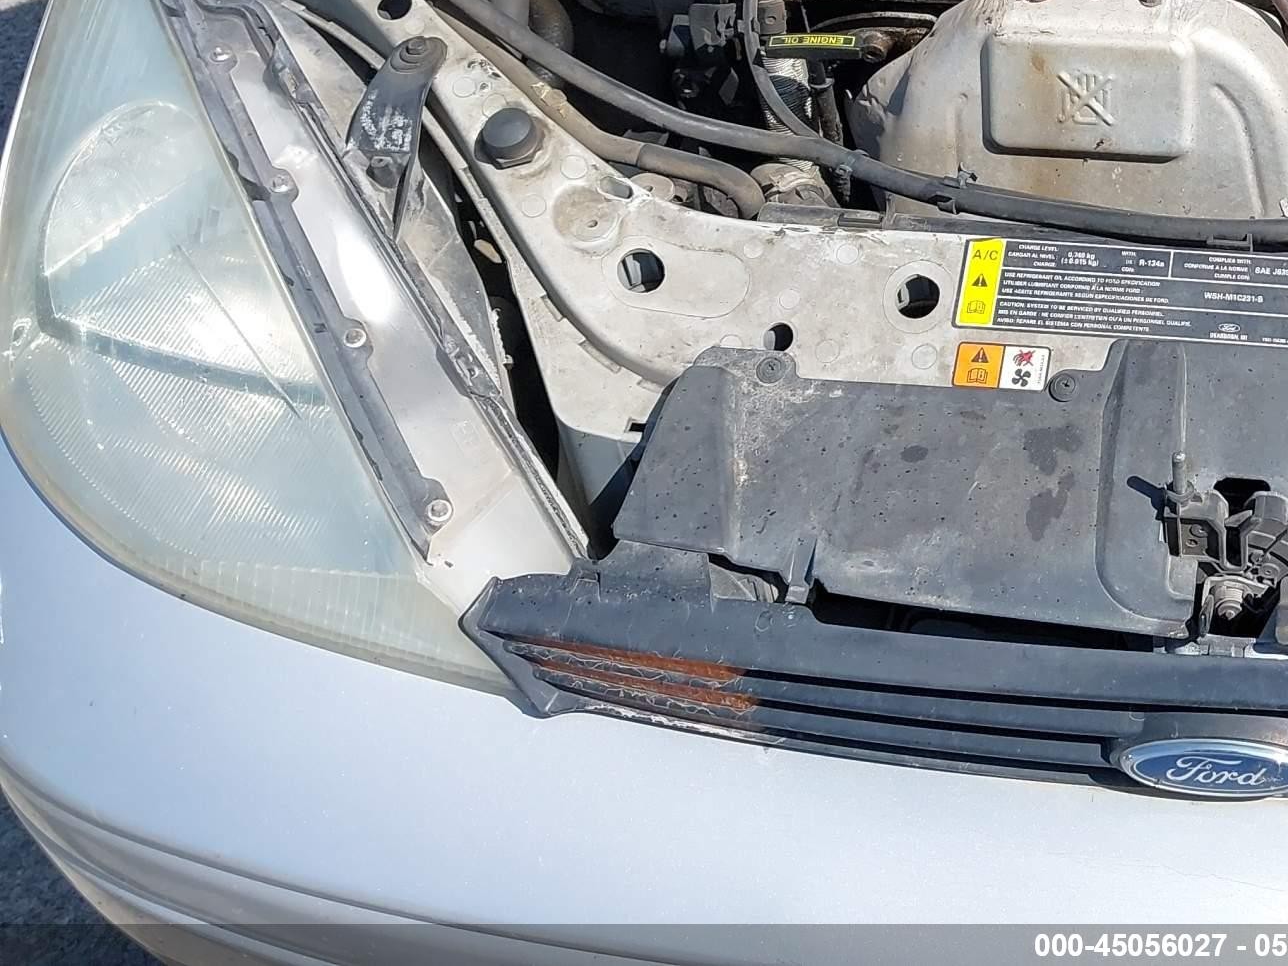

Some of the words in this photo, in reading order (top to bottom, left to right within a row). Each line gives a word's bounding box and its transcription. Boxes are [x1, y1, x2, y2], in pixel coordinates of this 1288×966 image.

[803, 36, 844, 44] ENGINE
[972, 249, 999, 260] A/C
[1087, 252, 1095, 260] kg
[1139, 259, 1165, 267] R-134a
[1255, 266, 1271, 274] SAE
[1016, 272, 1053, 280] REFRIGERANT
[1166, 756, 1266, 786] Ford
